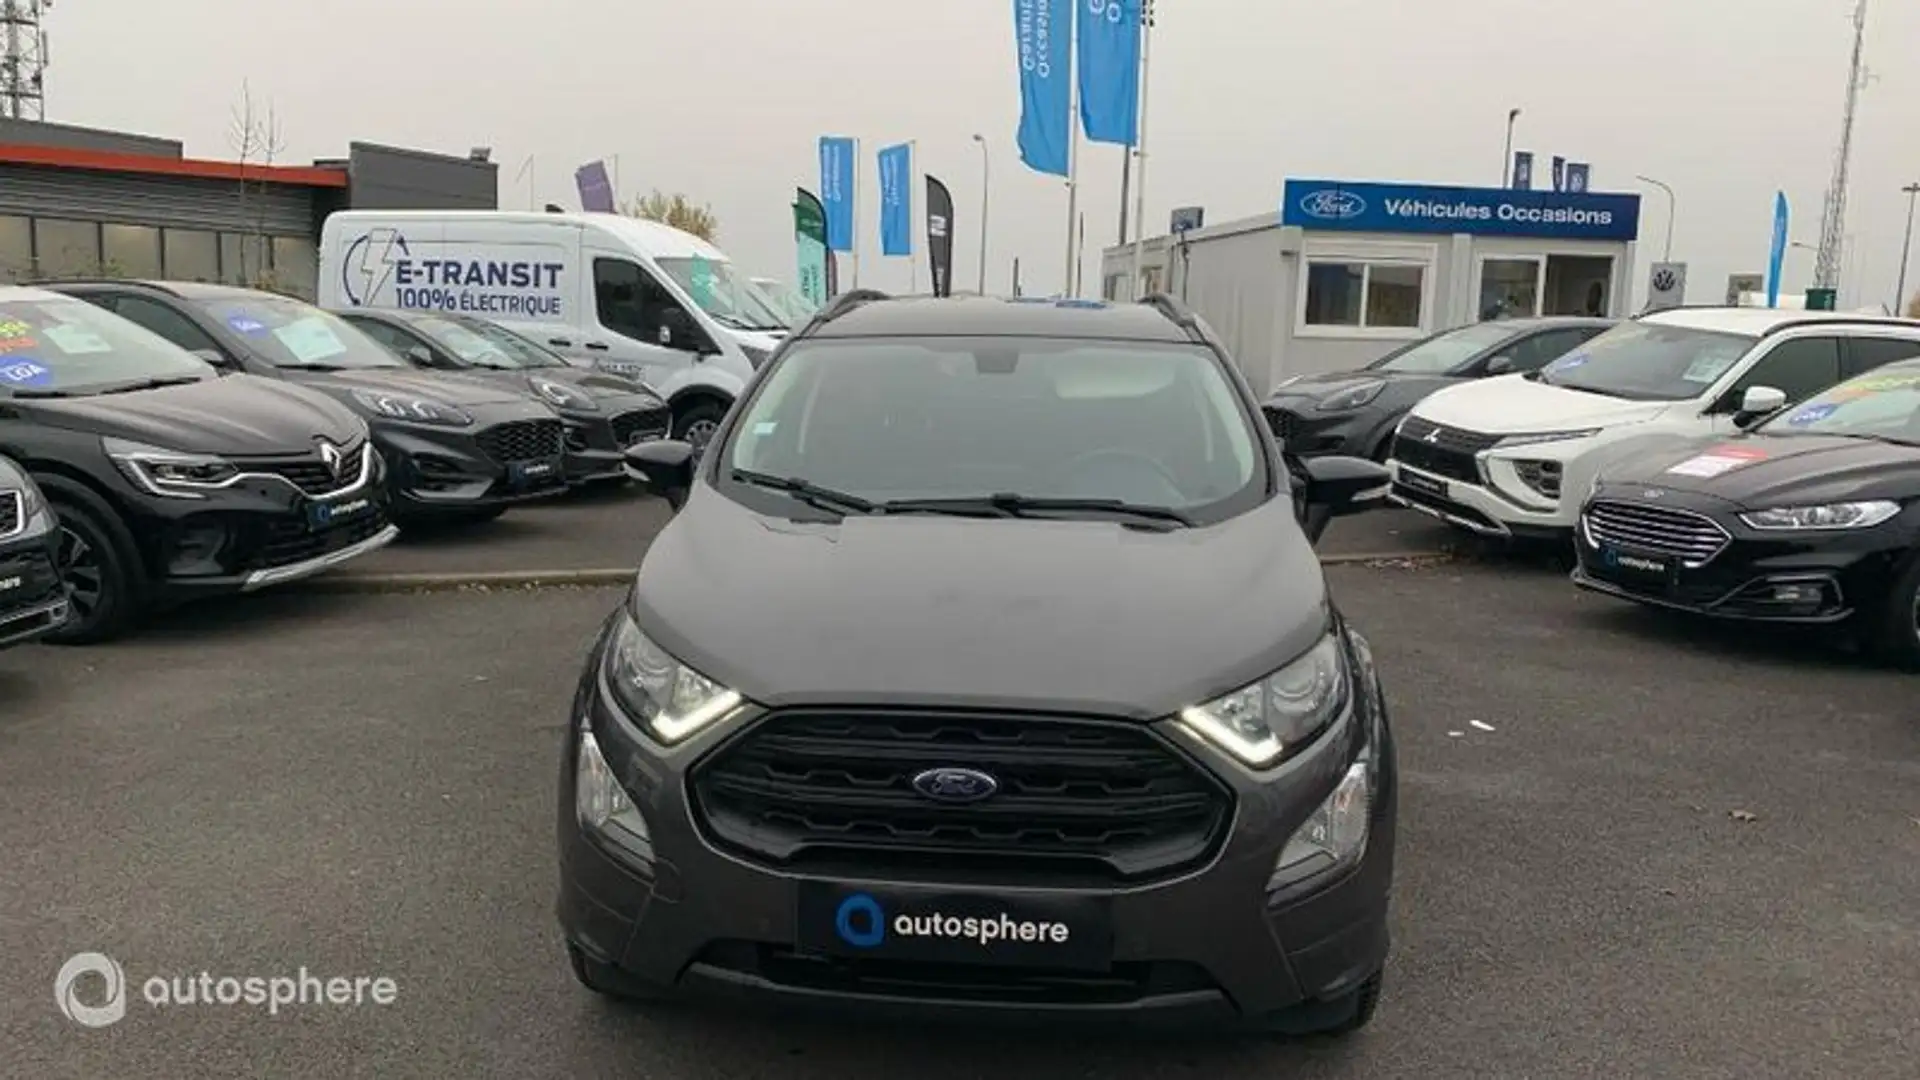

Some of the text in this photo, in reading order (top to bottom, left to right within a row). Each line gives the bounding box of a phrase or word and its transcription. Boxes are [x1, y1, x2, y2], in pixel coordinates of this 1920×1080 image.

[1308, 191, 1612, 225] Ford Véhicules Occasions
[396, 259, 563, 288] E-TRANSIT
[396, 287, 561, 315] 100% ÉLECTRIQUE
[894, 913, 1069, 945] autosphere
